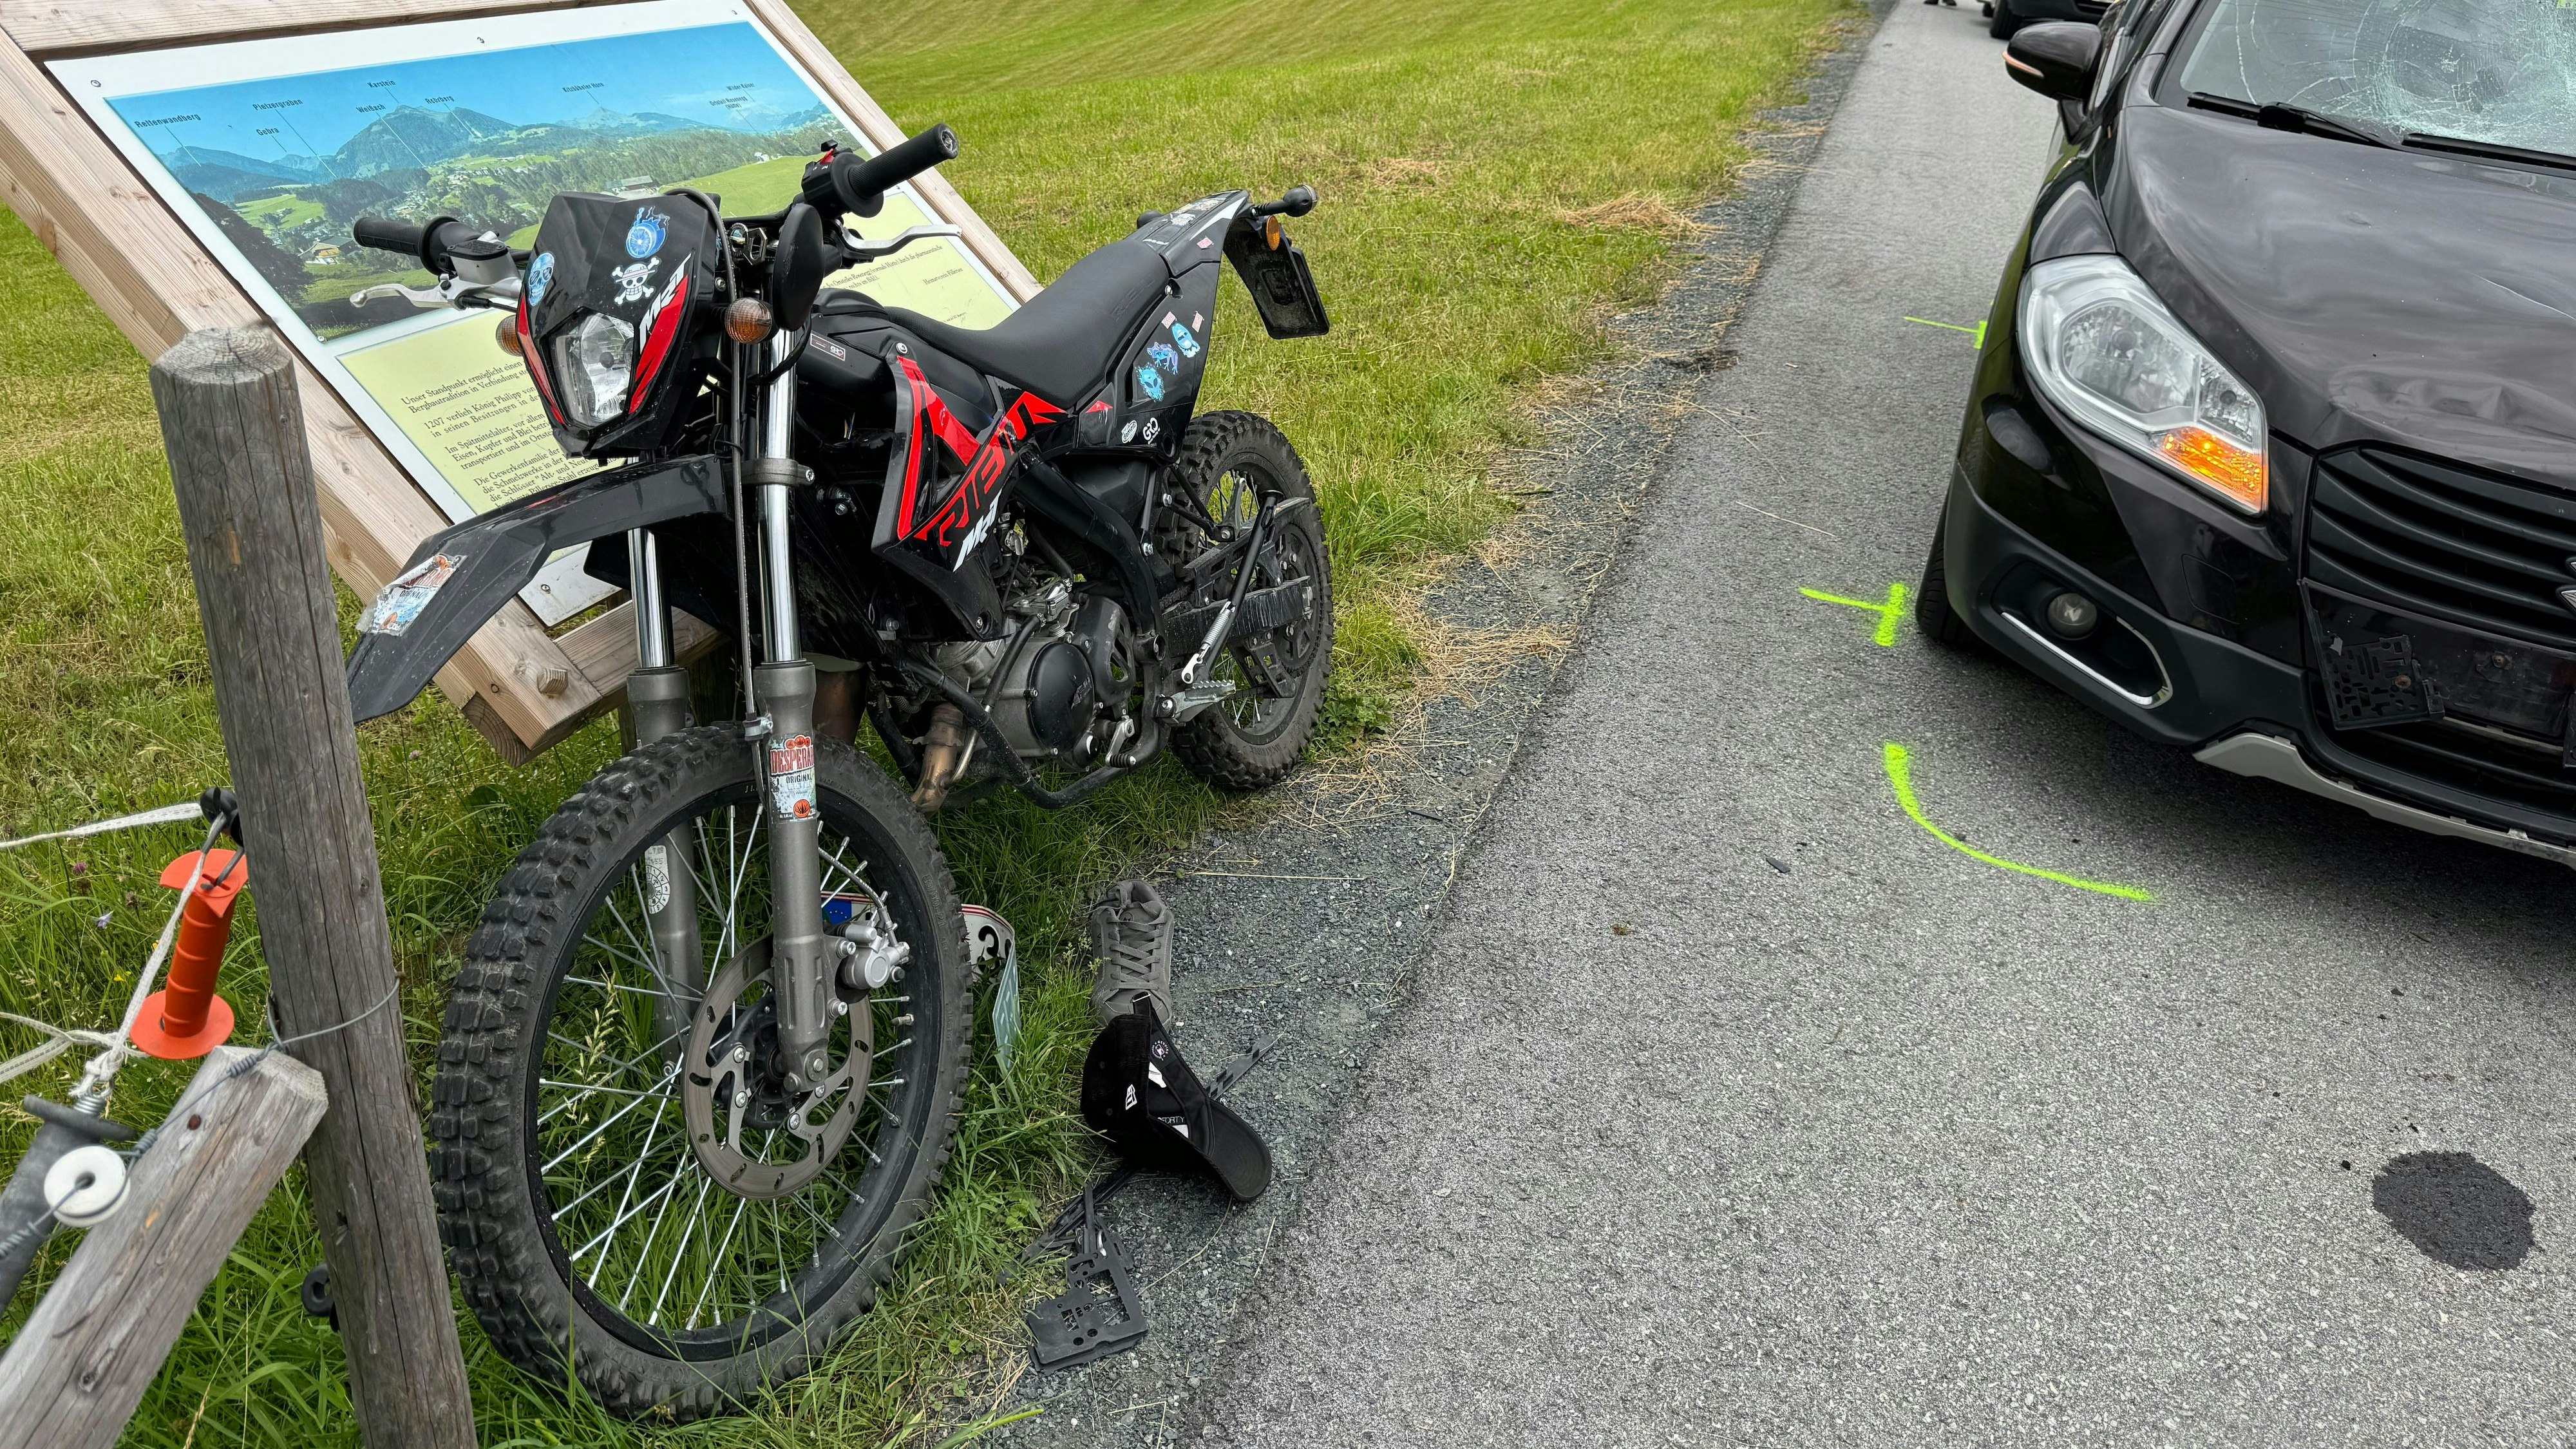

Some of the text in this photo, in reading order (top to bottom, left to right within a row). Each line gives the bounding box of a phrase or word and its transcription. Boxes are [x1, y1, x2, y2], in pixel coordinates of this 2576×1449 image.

[134, 113, 202, 128] Rettenwandberg
[256, 126, 279, 136] Gebra
[401, 361, 524, 405] Unser Standpunkt ermöglicht einen
[408, 390, 471, 414] Bergbautradition
[477, 371, 521, 389] Verbindung
[424, 417, 445, 430] 1207
[471, 399, 498, 413] König
[493, 391, 522, 407] Philipp
[443, 420, 471, 433] seinen
[469, 404, 517, 423] Besitzungen
[444, 413, 546, 455] Im Spätmittelalter, vor allem
[452, 448, 478, 462] Eisen,
[476, 439, 504, 455] Kupfer
[503, 432, 518, 444] und
[516, 426, 533, 437] Blei
[460, 449, 507, 470] transportiert
[506, 443, 522, 453] und
[473, 446, 560, 487] Die Gewerkenfamilie der
[577, 464, 600, 477] erzeug
[482, 484, 495, 495] die
[493, 465, 544, 489] Schmelzwerke
[552, 457, 564, 466] der
[490, 492, 502, 503] die
[500, 478, 537, 497] Schlösser
[554, 464, 571, 475] und
[786, 773, 813, 784] ORIGINAL
